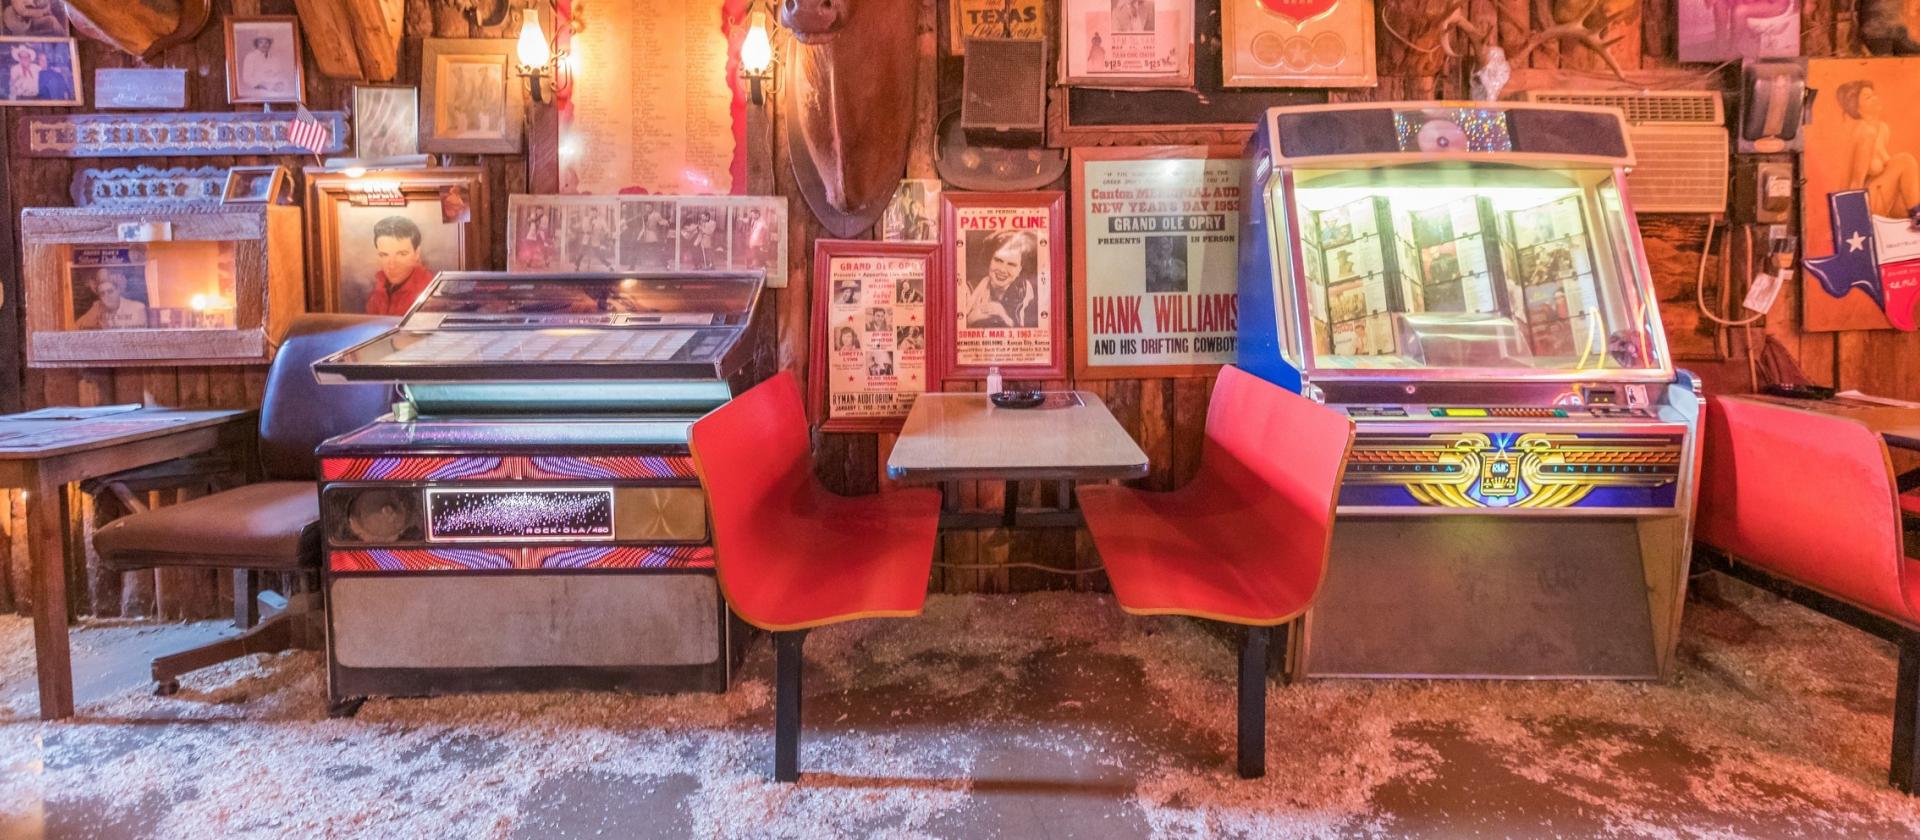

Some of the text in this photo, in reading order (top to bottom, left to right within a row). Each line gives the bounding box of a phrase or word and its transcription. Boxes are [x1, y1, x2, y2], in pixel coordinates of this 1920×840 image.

[966, 6, 1037, 24] TEXAS
[35, 125, 289, 144] THE SILVER DOLL
[1091, 188, 1133, 200] Canton
[1091, 202, 1123, 213] NEW
[1182, 200, 1210, 212] DAY
[1214, 199, 1240, 211] 1953
[960, 215, 1047, 230] PATSY CLINE
[1114, 216, 1222, 231] GRAND OLE OPRY
[1097, 237, 1141, 245] PRESENTS
[1202, 235, 1235, 243] PERSON
[840, 262, 871, 271] GRAND
[876, 262, 893, 270] OLE
[1092, 293, 1238, 334] HANK WILLIAMS
[1094, 339, 1116, 355] AND
[1120, 339, 1137, 355] HIS
[1141, 338, 1189, 354] DRIFTING
[833, 393, 854, 405] RYMAN
[858, 393, 893, 404] AUDITORIUM
